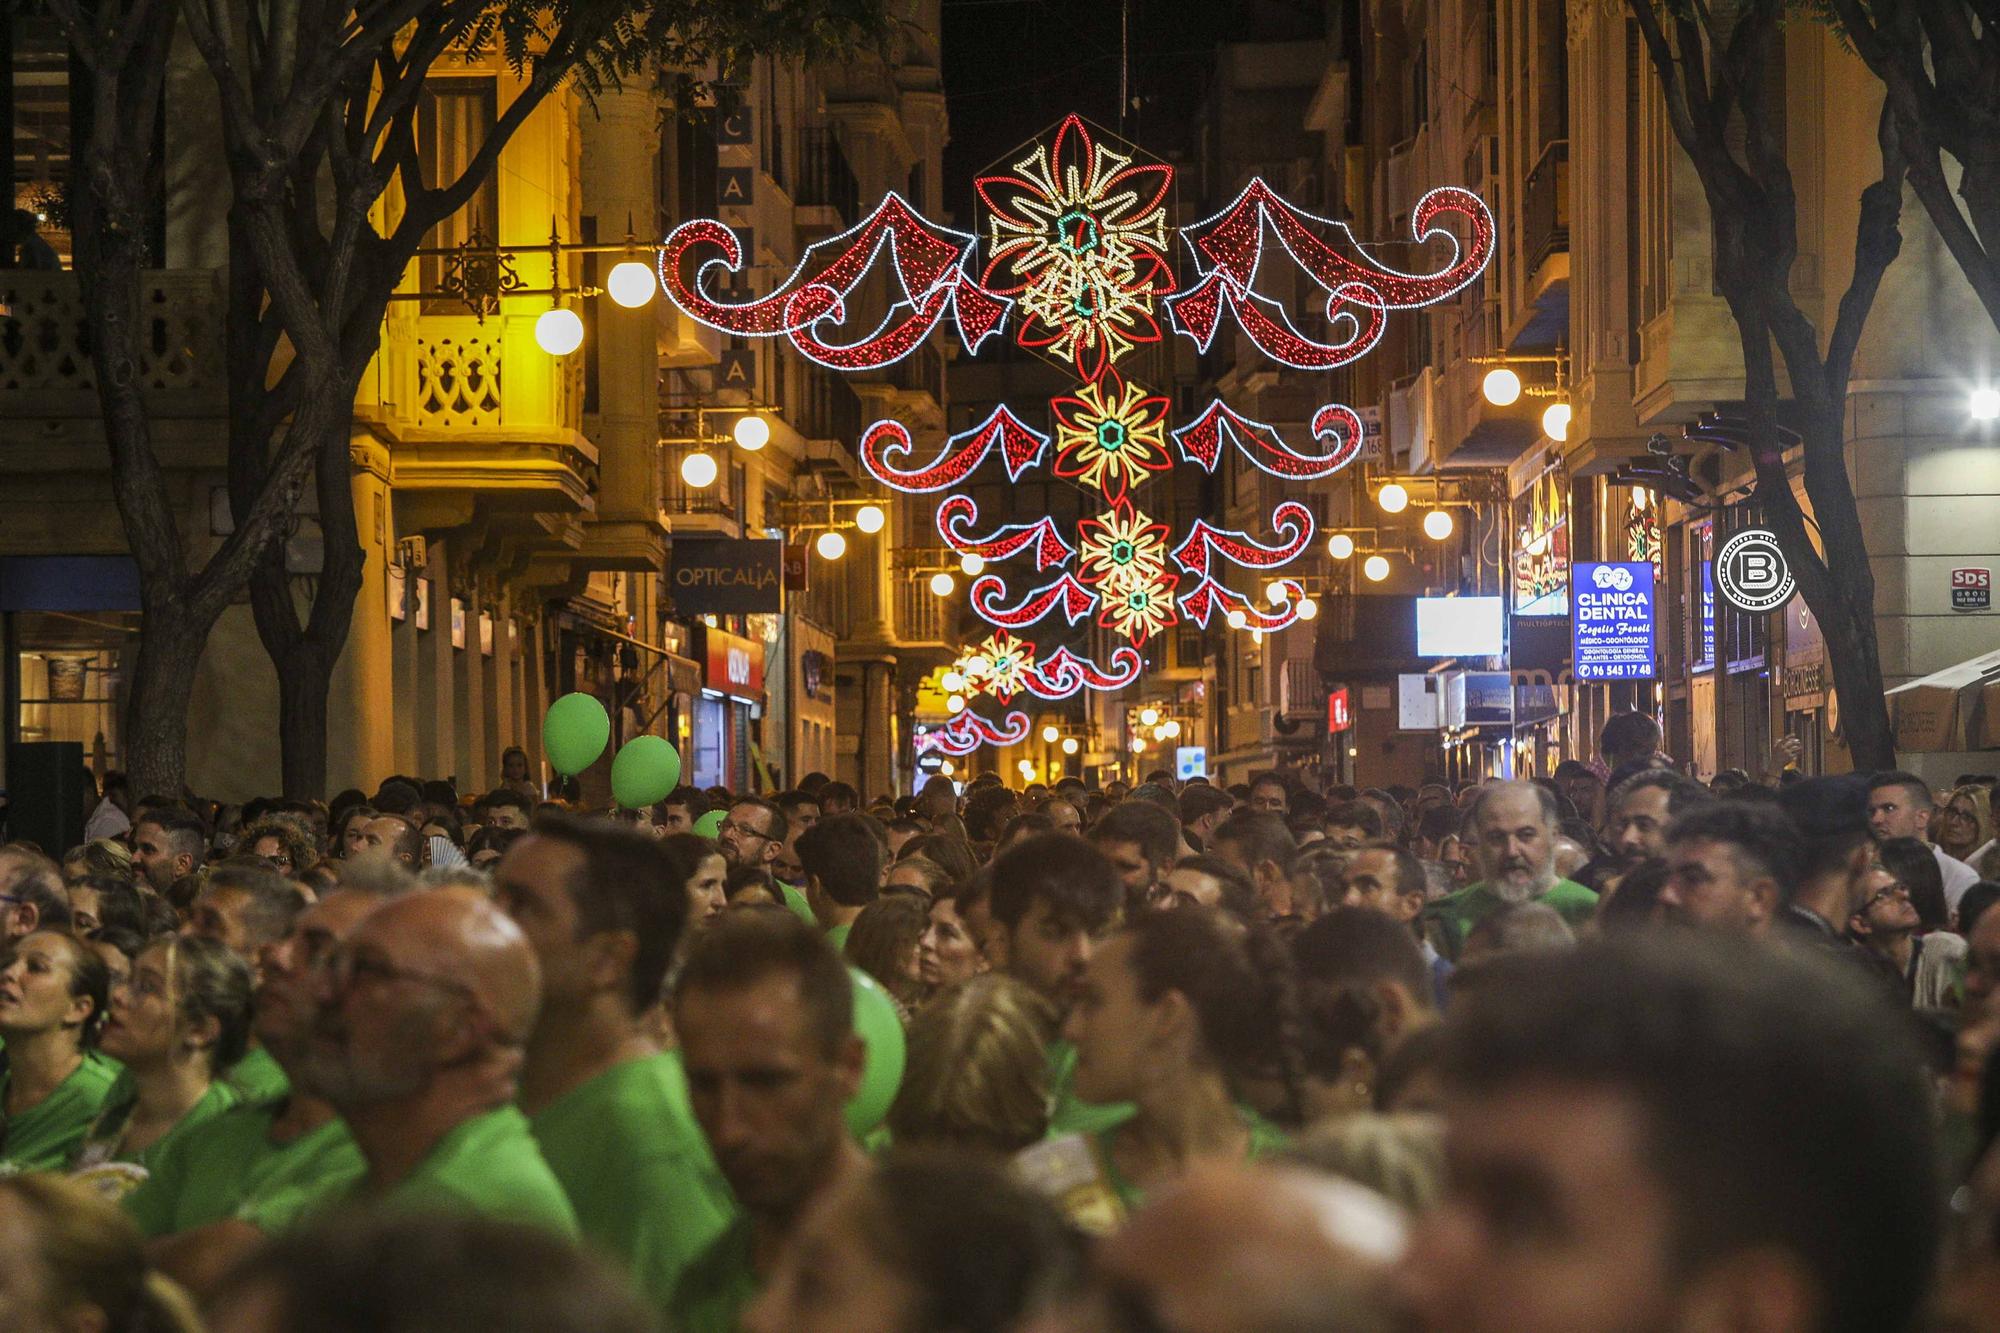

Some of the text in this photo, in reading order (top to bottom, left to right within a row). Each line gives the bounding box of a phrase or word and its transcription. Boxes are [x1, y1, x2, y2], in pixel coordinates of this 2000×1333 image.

[1739, 551, 1778, 589] B
[1954, 571, 1988, 586] SDS
[1578, 593, 1648, 606] CLINICA
[1579, 607, 1648, 620] DENTAL
[1578, 622, 1650, 637] Rogelio Fenoll
[1593, 665, 1603, 676] 96
[1606, 665, 1623, 676] 545
[1626, 665, 1637, 675] 17
